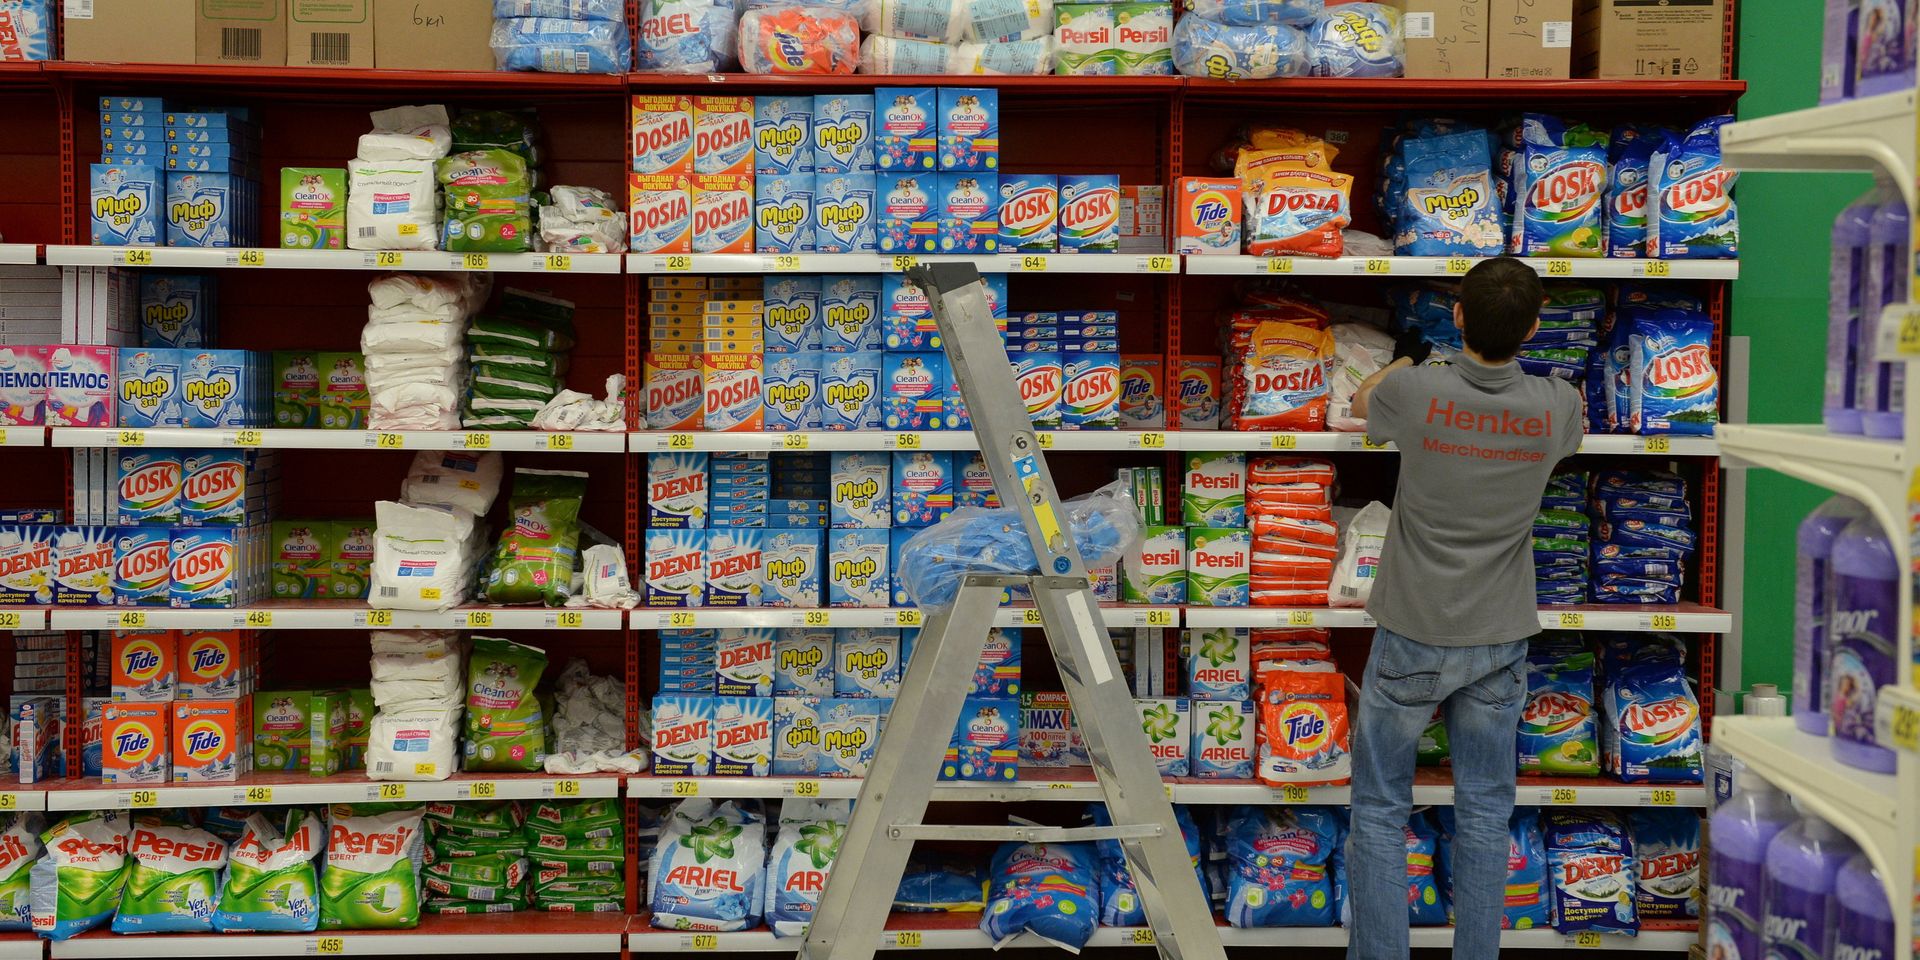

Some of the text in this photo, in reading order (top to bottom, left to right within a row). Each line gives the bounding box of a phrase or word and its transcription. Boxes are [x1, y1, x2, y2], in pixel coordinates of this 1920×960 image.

[1061, 26, 1109, 44] Persil
[1120, 26, 1168, 43] Persil
[639, 96, 676, 104] ВЫГОДНАЯ
[701, 97, 737, 105] ВЫГОДНАЯ
[888, 113, 922, 122] CleanOK
[635, 118, 690, 157] DOSIA
[697, 119, 750, 157] DOSIA
[760, 124, 802, 148] Миф
[820, 123, 861, 147] Миф
[1330, 133, 1347, 141] 380
[638, 175, 674, 183] ВЫГОДНАЯ
[699, 175, 736, 183] ВЫГОДНАЯ
[1536, 167, 1597, 208] LOSK
[295, 192, 330, 200] CleanOK
[890, 196, 924, 204] CleanOK
[950, 196, 984, 204] CleanOK
[96, 194, 141, 217] Миф
[1004, 192, 1050, 228] LOSK
[1064, 192, 1112, 228] LOSK
[1268, 193, 1340, 216] DOSIA
[172, 200, 215, 222] Миф
[633, 196, 687, 235] DOSIA
[694, 197, 749, 235] DOSIA
[822, 203, 863, 225] Миф
[1196, 201, 1228, 227] Tide
[129, 250, 144, 261] 34
[242, 251, 257, 262] 48
[380, 252, 394, 263] 78
[467, 254, 483, 266] 166
[549, 256, 562, 267] 18
[896, 256, 910, 266] 56
[669, 257, 683, 267] 28
[778, 257, 792, 267] 39
[1024, 257, 1039, 268] 64
[1152, 258, 1166, 268] 67
[1272, 259, 1287, 270] 127
[1368, 260, 1382, 271] 87
[1450, 261, 1466, 271] 155
[1550, 262, 1567, 273] 256
[1647, 262, 1663, 273] 315
[769, 304, 810, 327] Миф
[654, 354, 689, 362] ВЫГОДНАЯ
[711, 354, 747, 362] ВЫГОДНАЯ
[1653, 351, 1709, 386] LOSK
[47, 371, 109, 389] ПЕМОС
[1255, 364, 1322, 393] DOSIA
[124, 377, 168, 399] Миф
[650, 375, 701, 413] DOSIA
[769, 381, 809, 404] Миф
[1067, 377, 1112, 404] LOSK
[1180, 379, 1208, 399] Tide
[707, 375, 760, 414] DOSIA
[1426, 397, 1552, 437] Henkel
[122, 431, 137, 443] 34
[239, 431, 253, 443] 48
[381, 434, 395, 445] 78
[468, 434, 485, 445] 166
[551, 435, 565, 446] 18
[672, 435, 687, 446] 28
[787, 435, 801, 445] 39
[900, 434, 913, 445] 56
[1016, 437, 1027, 449] 6
[1143, 434, 1159, 445] 67
[1274, 436, 1290, 447] 127
[1424, 436, 1546, 464] Merchandiser
[1648, 439, 1665, 449] 315
[906, 470, 939, 478] CleanOK
[125, 466, 173, 498] LOSK
[189, 467, 236, 498] LOSK
[1191, 472, 1239, 490] Persil
[652, 473, 703, 502] DENI
[59, 549, 113, 578] DENI
[176, 545, 225, 580] LOSK
[650, 552, 701, 580] DENI
[709, 551, 761, 580] DENI
[1196, 551, 1243, 569] Persil
[835, 558, 875, 580] Миф
[649, 595, 682, 603] Доступное
[709, 594, 741, 602] Доступное
[0, 613, 12, 625] 32
[123, 612, 138, 624] 48
[249, 612, 264, 623] 48
[370, 611, 385, 623] 78
[470, 612, 487, 623] 166
[561, 612, 574, 623] 18
[673, 613, 687, 624] 37
[808, 612, 821, 623] 39
[900, 611, 914, 622] 56
[1027, 610, 1040, 621] 69
[1149, 611, 1164, 622] 81
[1291, 611, 1308, 623] 190
[1562, 614, 1578, 624] 256
[1654, 615, 1670, 627] 315
[192, 649, 225, 671] Tide
[720, 641, 772, 670] DENI
[125, 651, 159, 675] Tide
[1194, 669, 1245, 682] ARIEL
[474, 683, 521, 698] CleanOK
[1019, 709, 1063, 729] BiMAX
[1630, 700, 1686, 731] LOSK
[656, 720, 708, 749] DENI
[716, 721, 768, 749] DENI
[1030, 732, 1047, 740] 100
[1285, 716, 1325, 745] Tide
[116, 734, 149, 758] Tide
[187, 732, 221, 755] Tide
[1201, 747, 1249, 760] ARIEL
[383, 785, 398, 796] 78
[473, 783, 489, 795] 166
[558, 781, 572, 793] 18
[676, 782, 690, 792] 37
[798, 782, 812, 793] 39
[134, 792, 149, 803] 50
[249, 788, 264, 799] 48
[1287, 788, 1304, 799] 190
[1555, 789, 1571, 801] 256
[1654, 791, 1671, 802] 315
[132, 829, 224, 862] Persil
[329, 826, 415, 855] Persil
[1564, 855, 1624, 885] DENI
[666, 865, 744, 892] ARIEL
[1564, 907, 1608, 915] Доступное
[696, 936, 712, 946] 677
[900, 933, 916, 944] 371
[1136, 930, 1152, 940] 543
[1579, 933, 1595, 944] 257
[321, 939, 338, 951] 455
